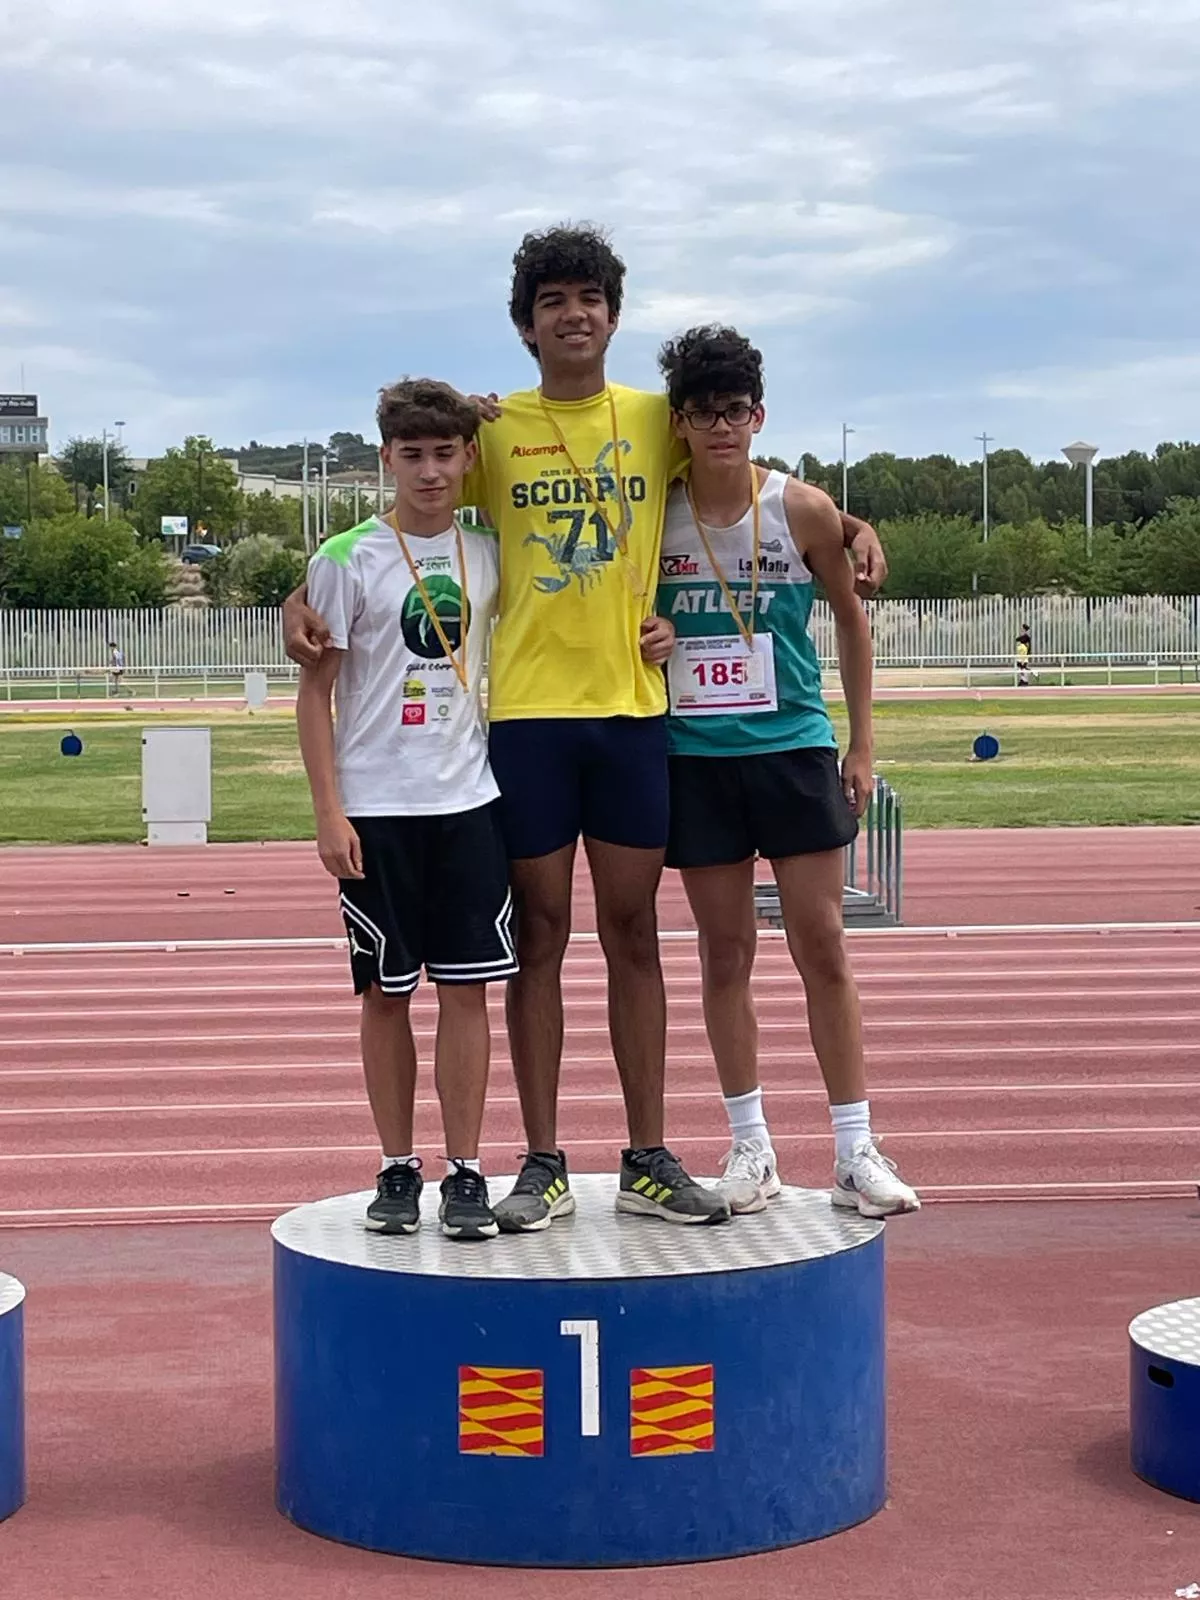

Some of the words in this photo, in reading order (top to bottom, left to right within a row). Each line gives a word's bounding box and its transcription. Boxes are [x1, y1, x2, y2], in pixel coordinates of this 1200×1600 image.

[547, 509, 614, 563] 71
[739, 558, 753, 571] La
[756, 556, 790, 573] Mafia
[692, 662, 748, 687] 185
[560, 1320, 599, 1436] 1
